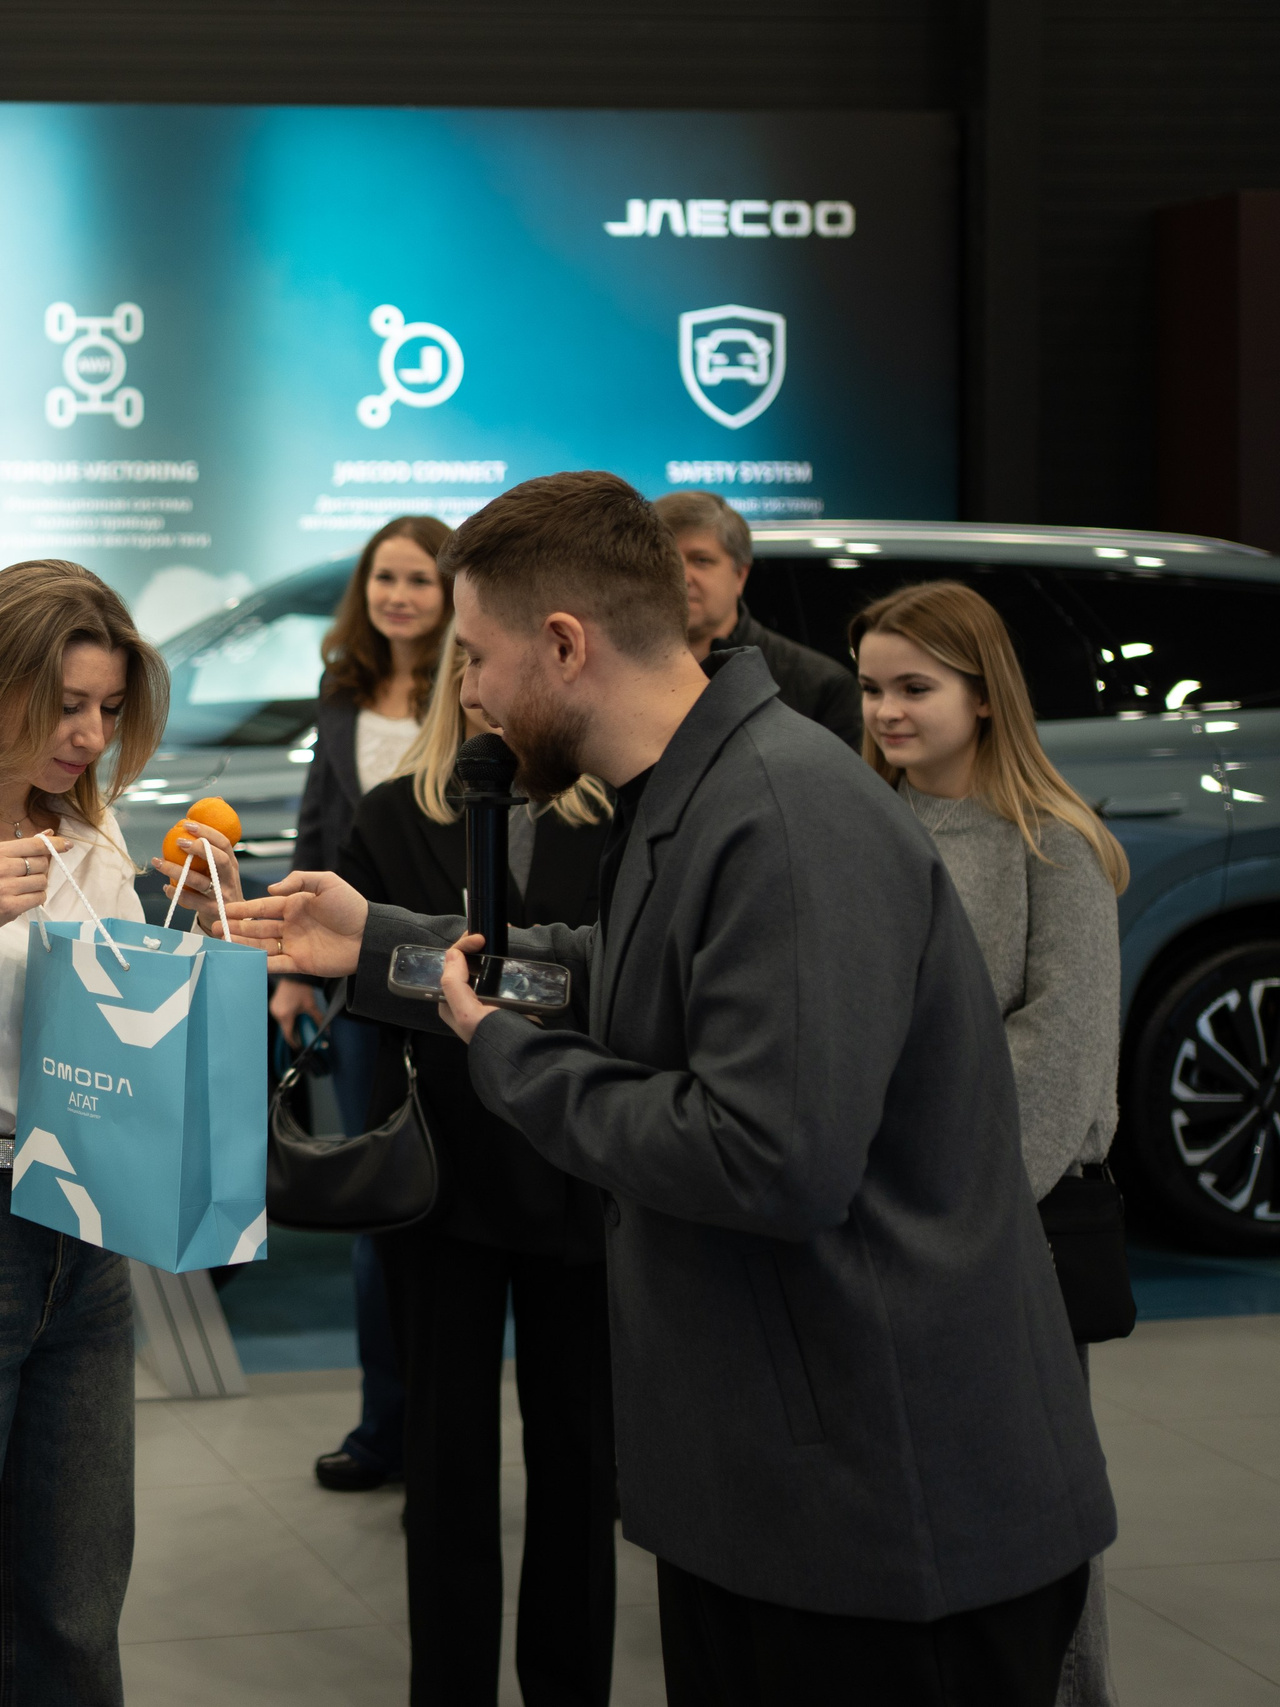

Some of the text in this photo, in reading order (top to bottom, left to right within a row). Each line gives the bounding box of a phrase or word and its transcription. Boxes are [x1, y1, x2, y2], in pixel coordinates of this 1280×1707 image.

[604, 199, 856, 238] JAECOO
[666, 461, 813, 484] SAFETY SYSTEM
[42, 1057, 133, 1097] OMODA
[68, 1091, 99, 1112] АГАТ
